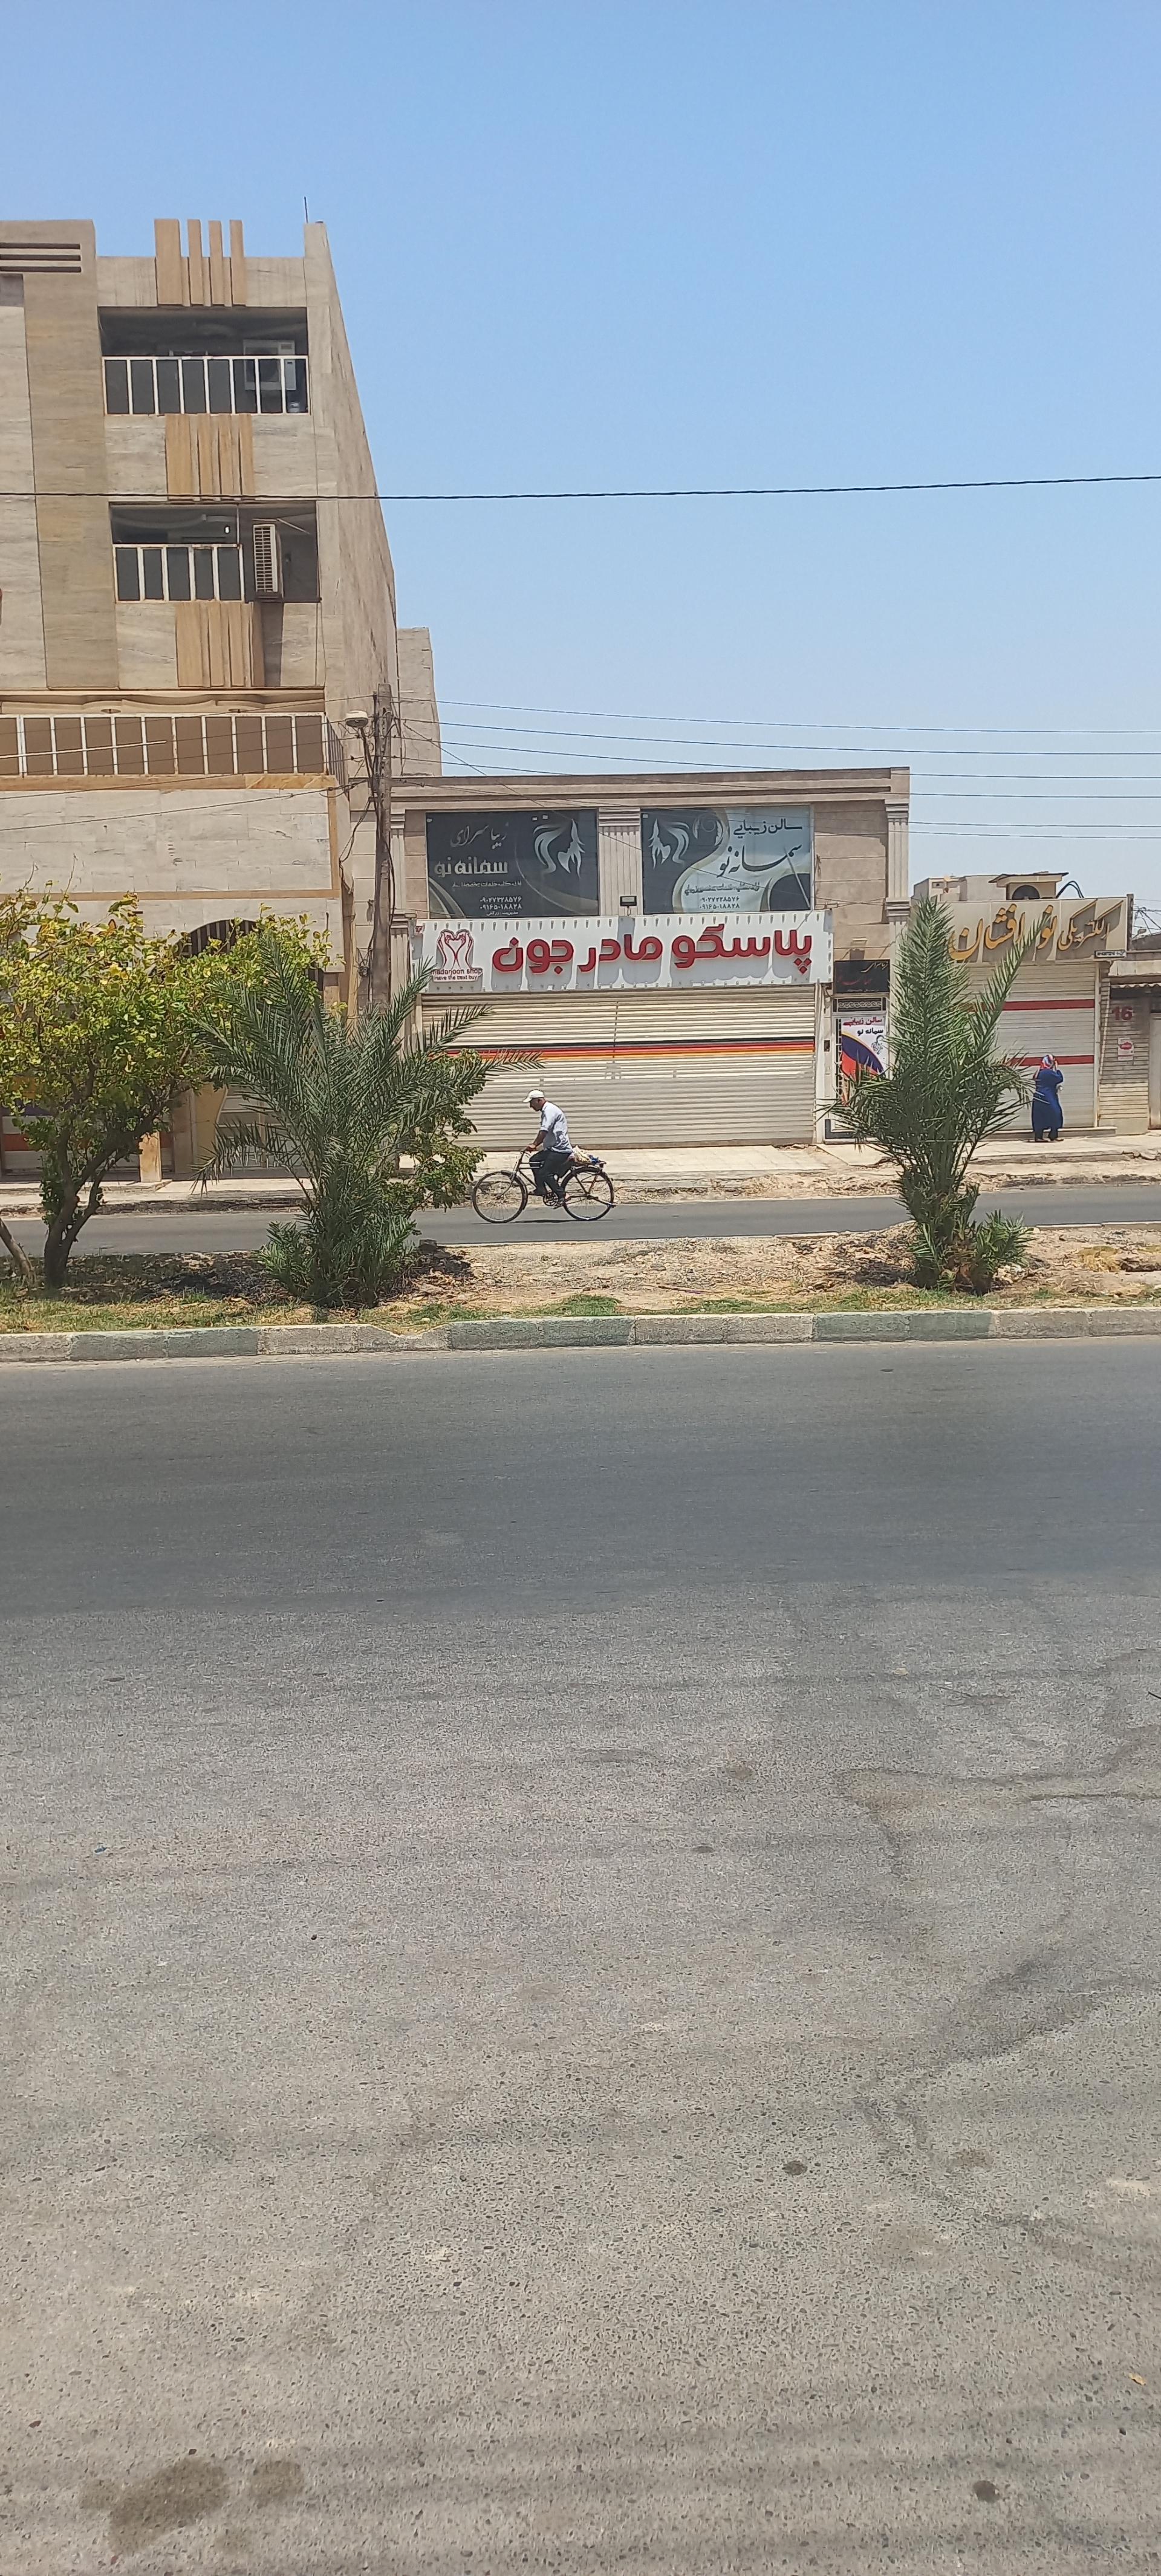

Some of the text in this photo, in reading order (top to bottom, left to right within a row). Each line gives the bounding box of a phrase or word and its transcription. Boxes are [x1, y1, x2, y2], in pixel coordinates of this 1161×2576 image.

[768, 818, 802, 833] سالن
[434, 856, 508, 877] سمانه نو
[717, 846, 732, 877] نو
[492, 937, 574, 974] جون
[577, 934, 663, 973] مادر
[865, 1016, 882, 1025] سالن
[1112, 1006, 1133, 1020] 16
